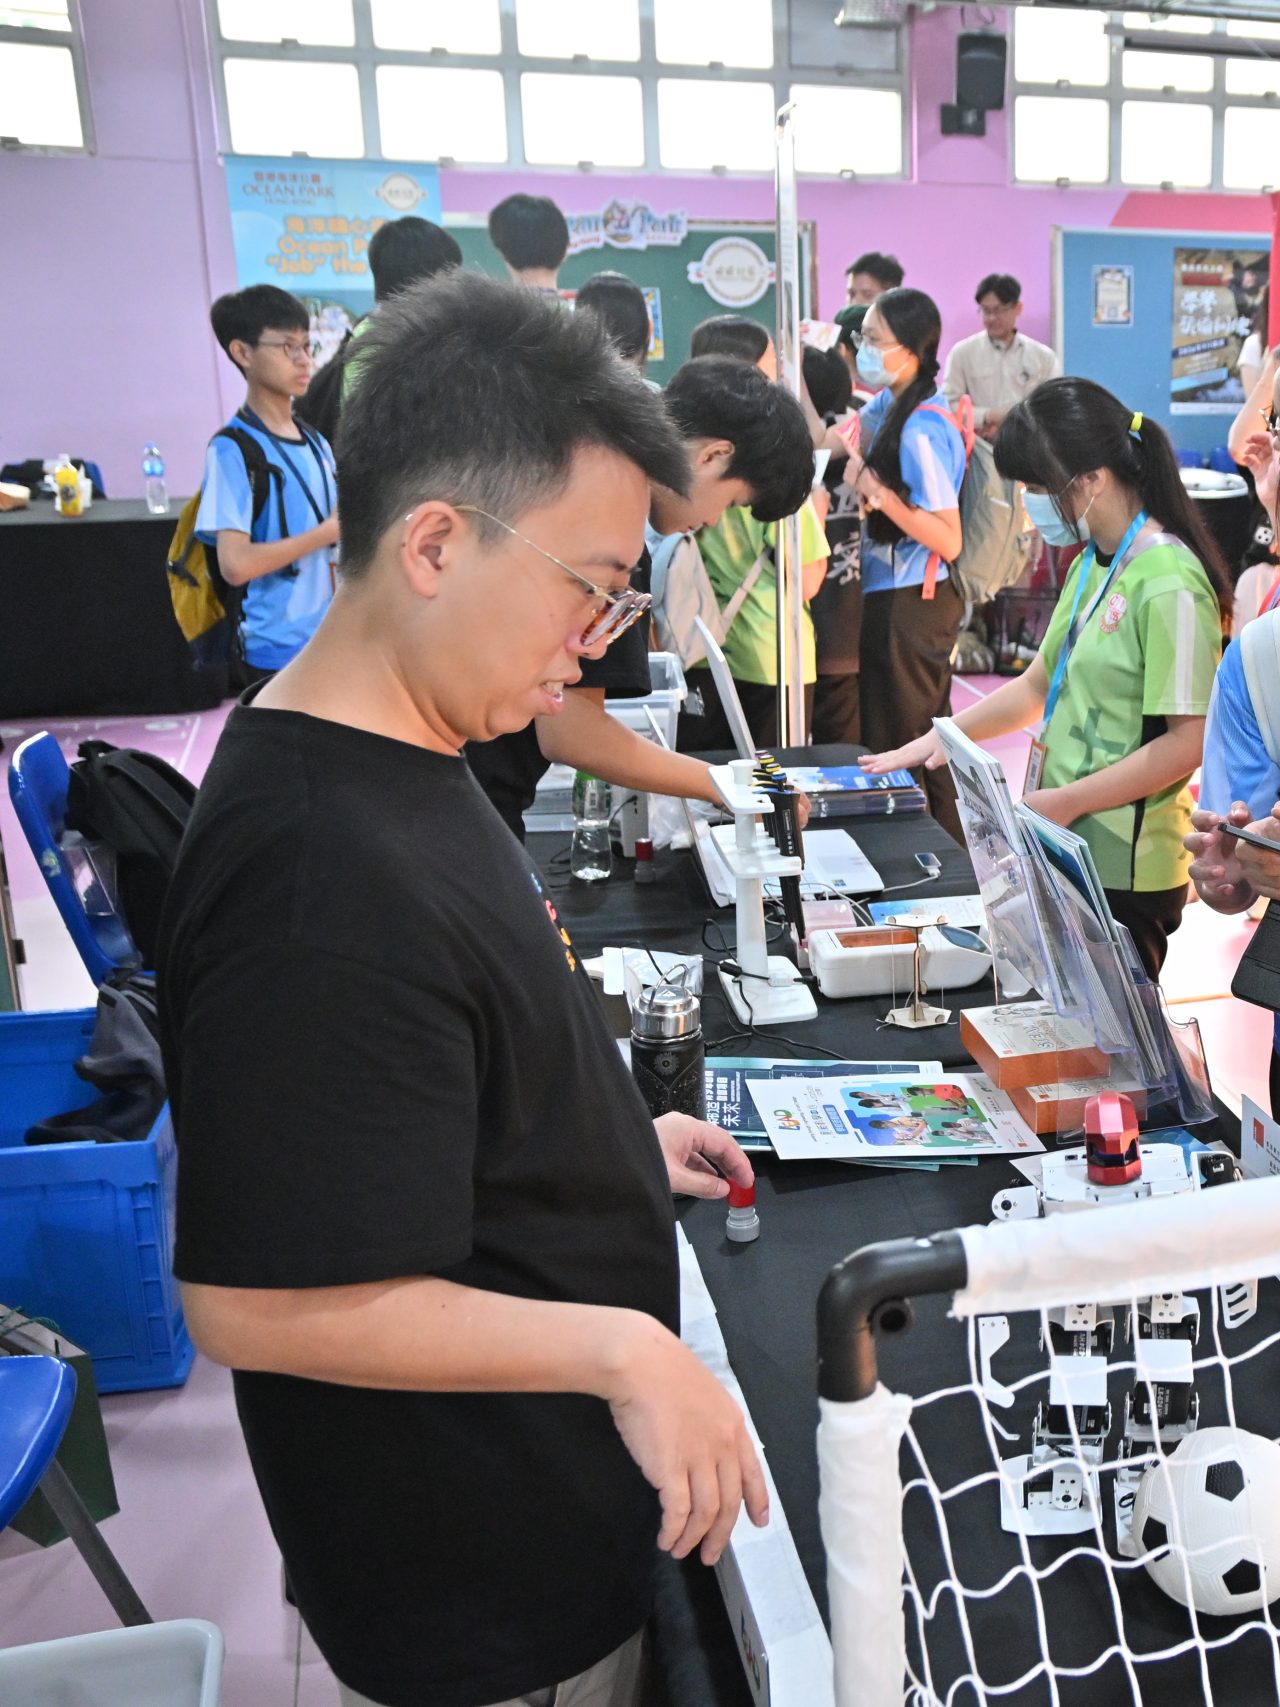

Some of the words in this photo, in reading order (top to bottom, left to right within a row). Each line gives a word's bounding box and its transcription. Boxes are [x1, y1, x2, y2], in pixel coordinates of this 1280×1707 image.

[242, 184, 295, 197] OCEAN
[299, 186, 335, 198] PARK
[278, 235, 348, 255] Ocean
[332, 255, 367, 275] the
[722, 1102, 741, 1127] 未來
[773, 1109, 801, 1131] LEAD
